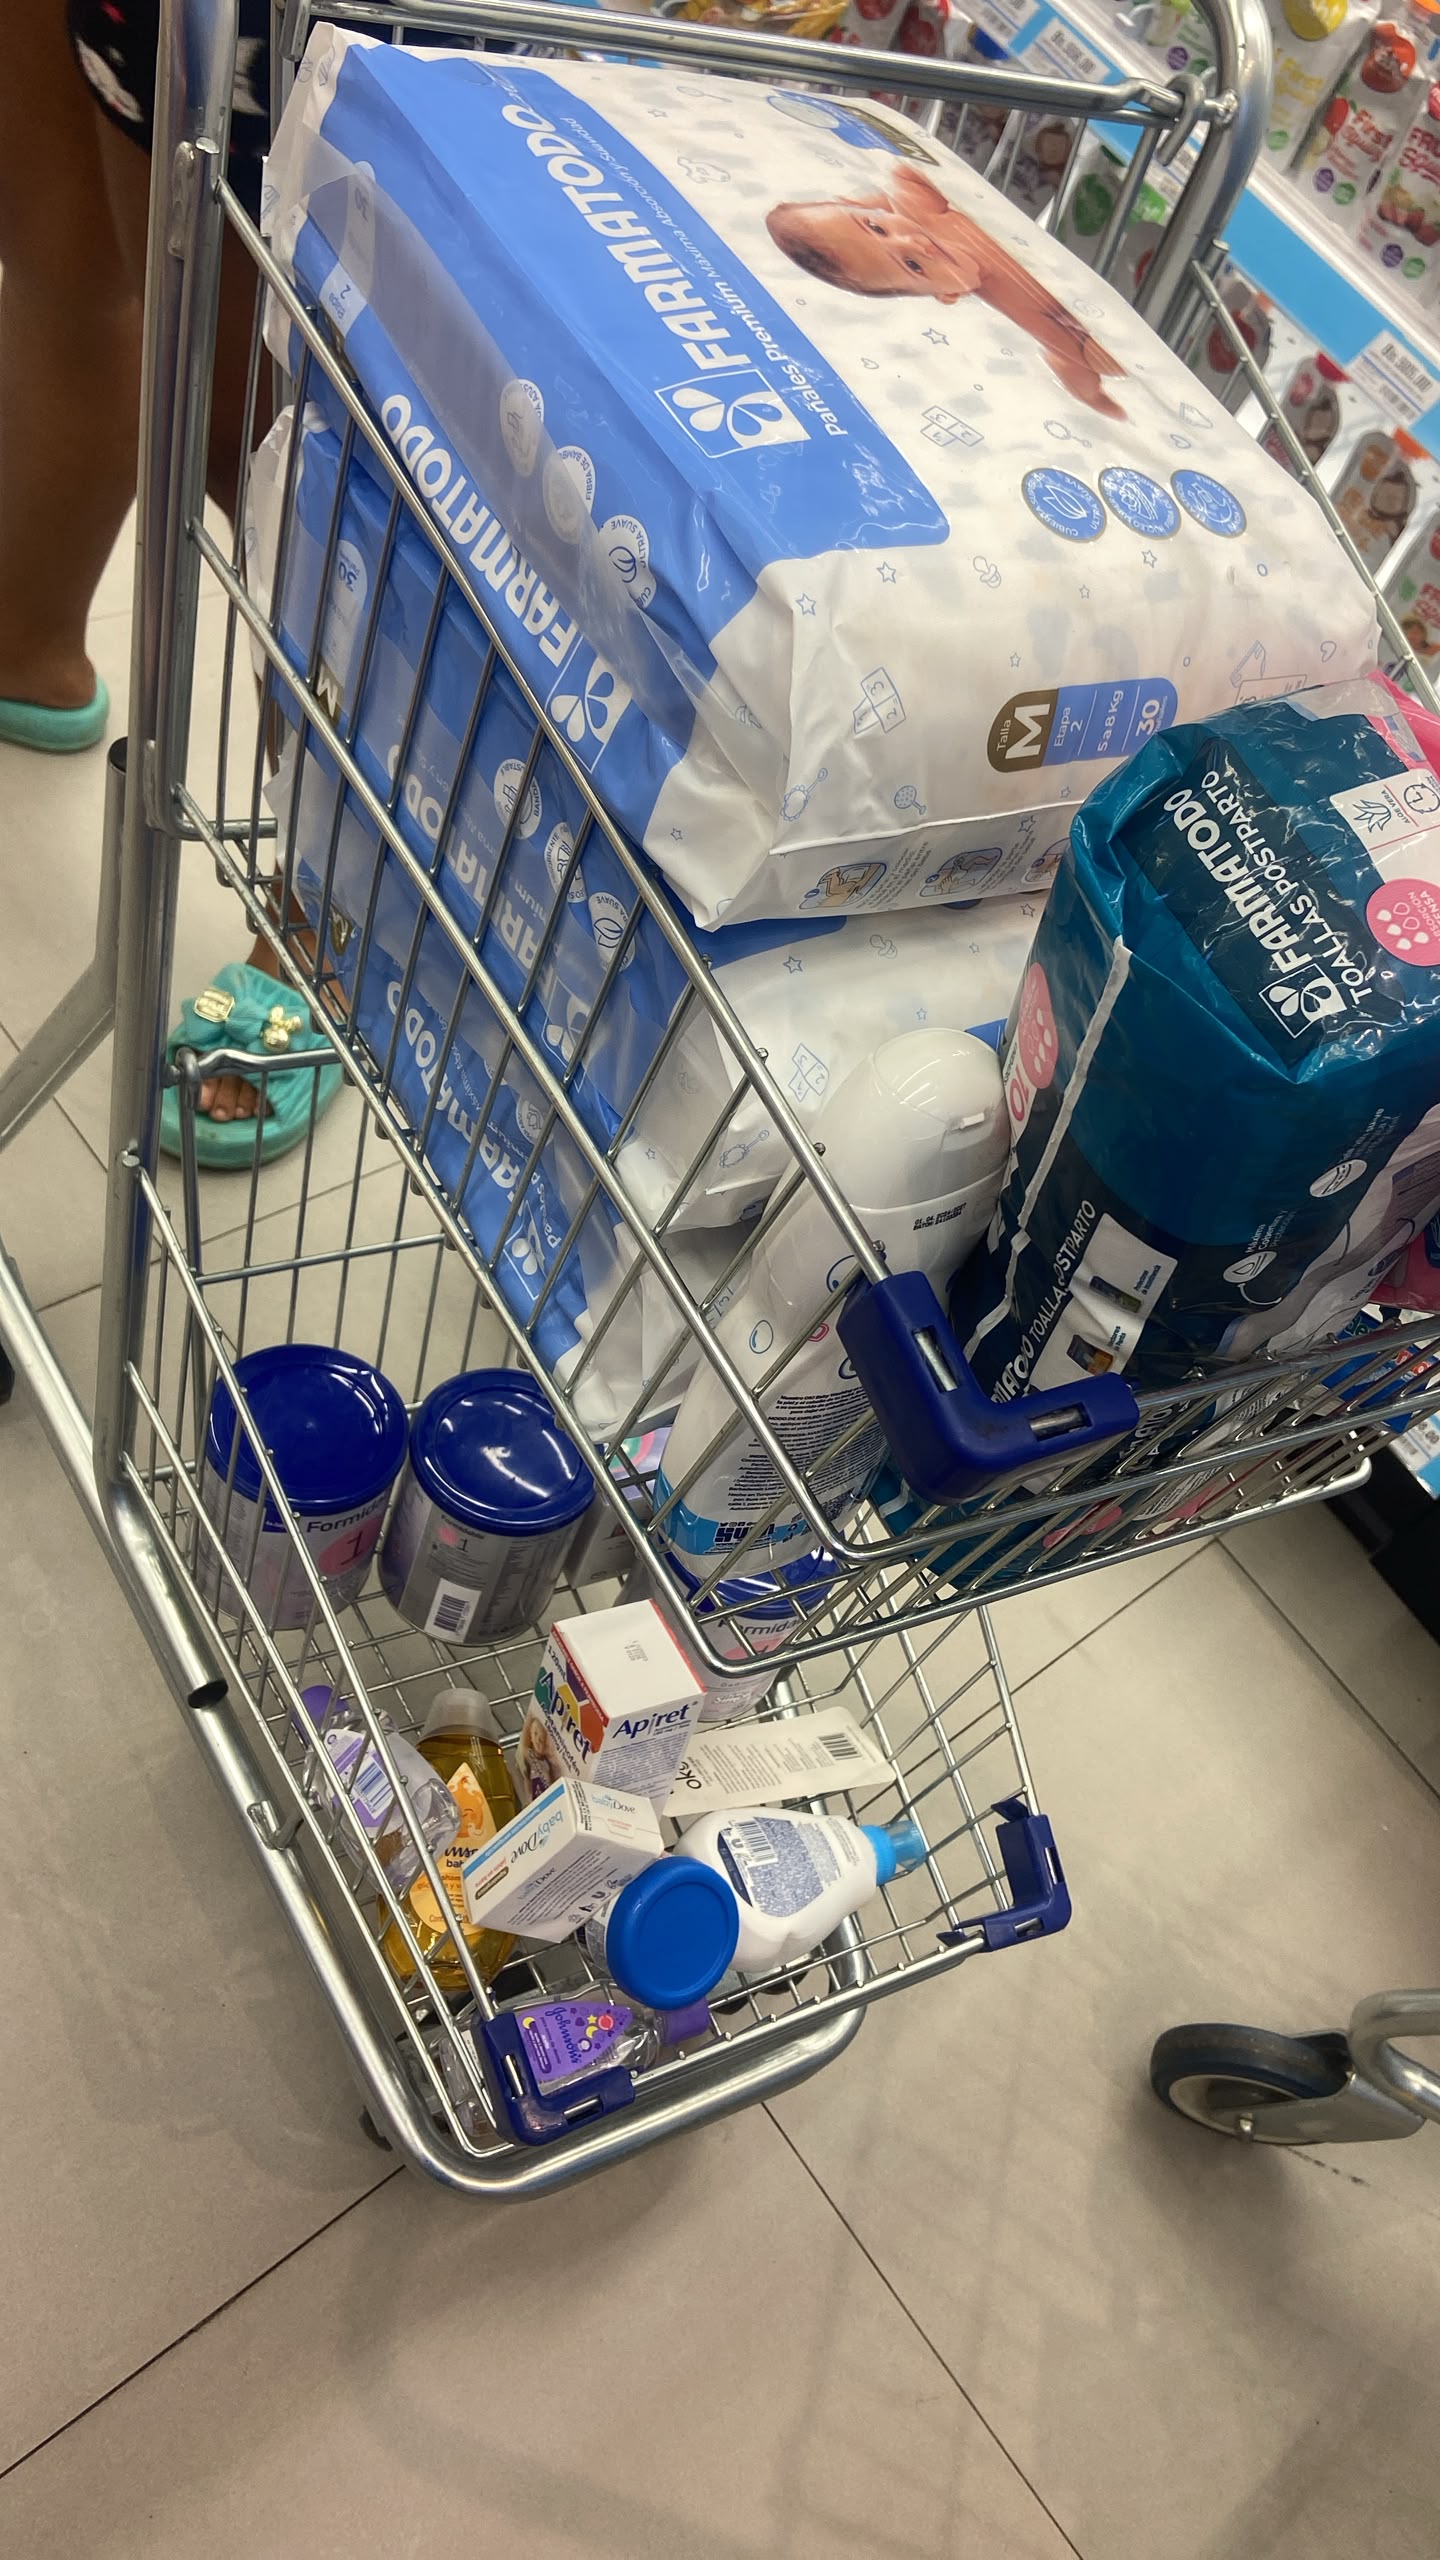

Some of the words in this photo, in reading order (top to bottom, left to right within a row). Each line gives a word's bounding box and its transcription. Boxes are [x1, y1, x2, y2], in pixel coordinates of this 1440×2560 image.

[502, 105, 752, 370] FARMATODO
[715, 281, 788, 363] Premium
[781, 364, 848, 436] Pañales
[381, 394, 582, 668] FARMATODO
[610, 518, 638, 533] SUAVE
[996, 719, 1012, 752] Talla
[1005, 703, 1051, 760] M
[1054, 707, 1072, 747] Etapa
[1070, 720, 1085, 733] 2
[1135, 699, 1161, 737] 30
[1381, 789, 1396, 809] VERA
[1393, 808, 1411, 825] ALOE
[1200, 770, 1299, 895] POSTPARTO
[1163, 788, 1313, 974] FARMATODO
[1289, 894, 1372, 1005] TOALLAS
[340, 1531, 364, 1567] 1
[456, 1539, 469, 1553] 1
[540, 1672, 591, 1764] Apiret
[612, 1704, 691, 1740] Apiret
[536, 1809, 564, 1840] baby
[510, 1831, 540, 1864] Dove
[545, 2007, 582, 2064] Johnson's
